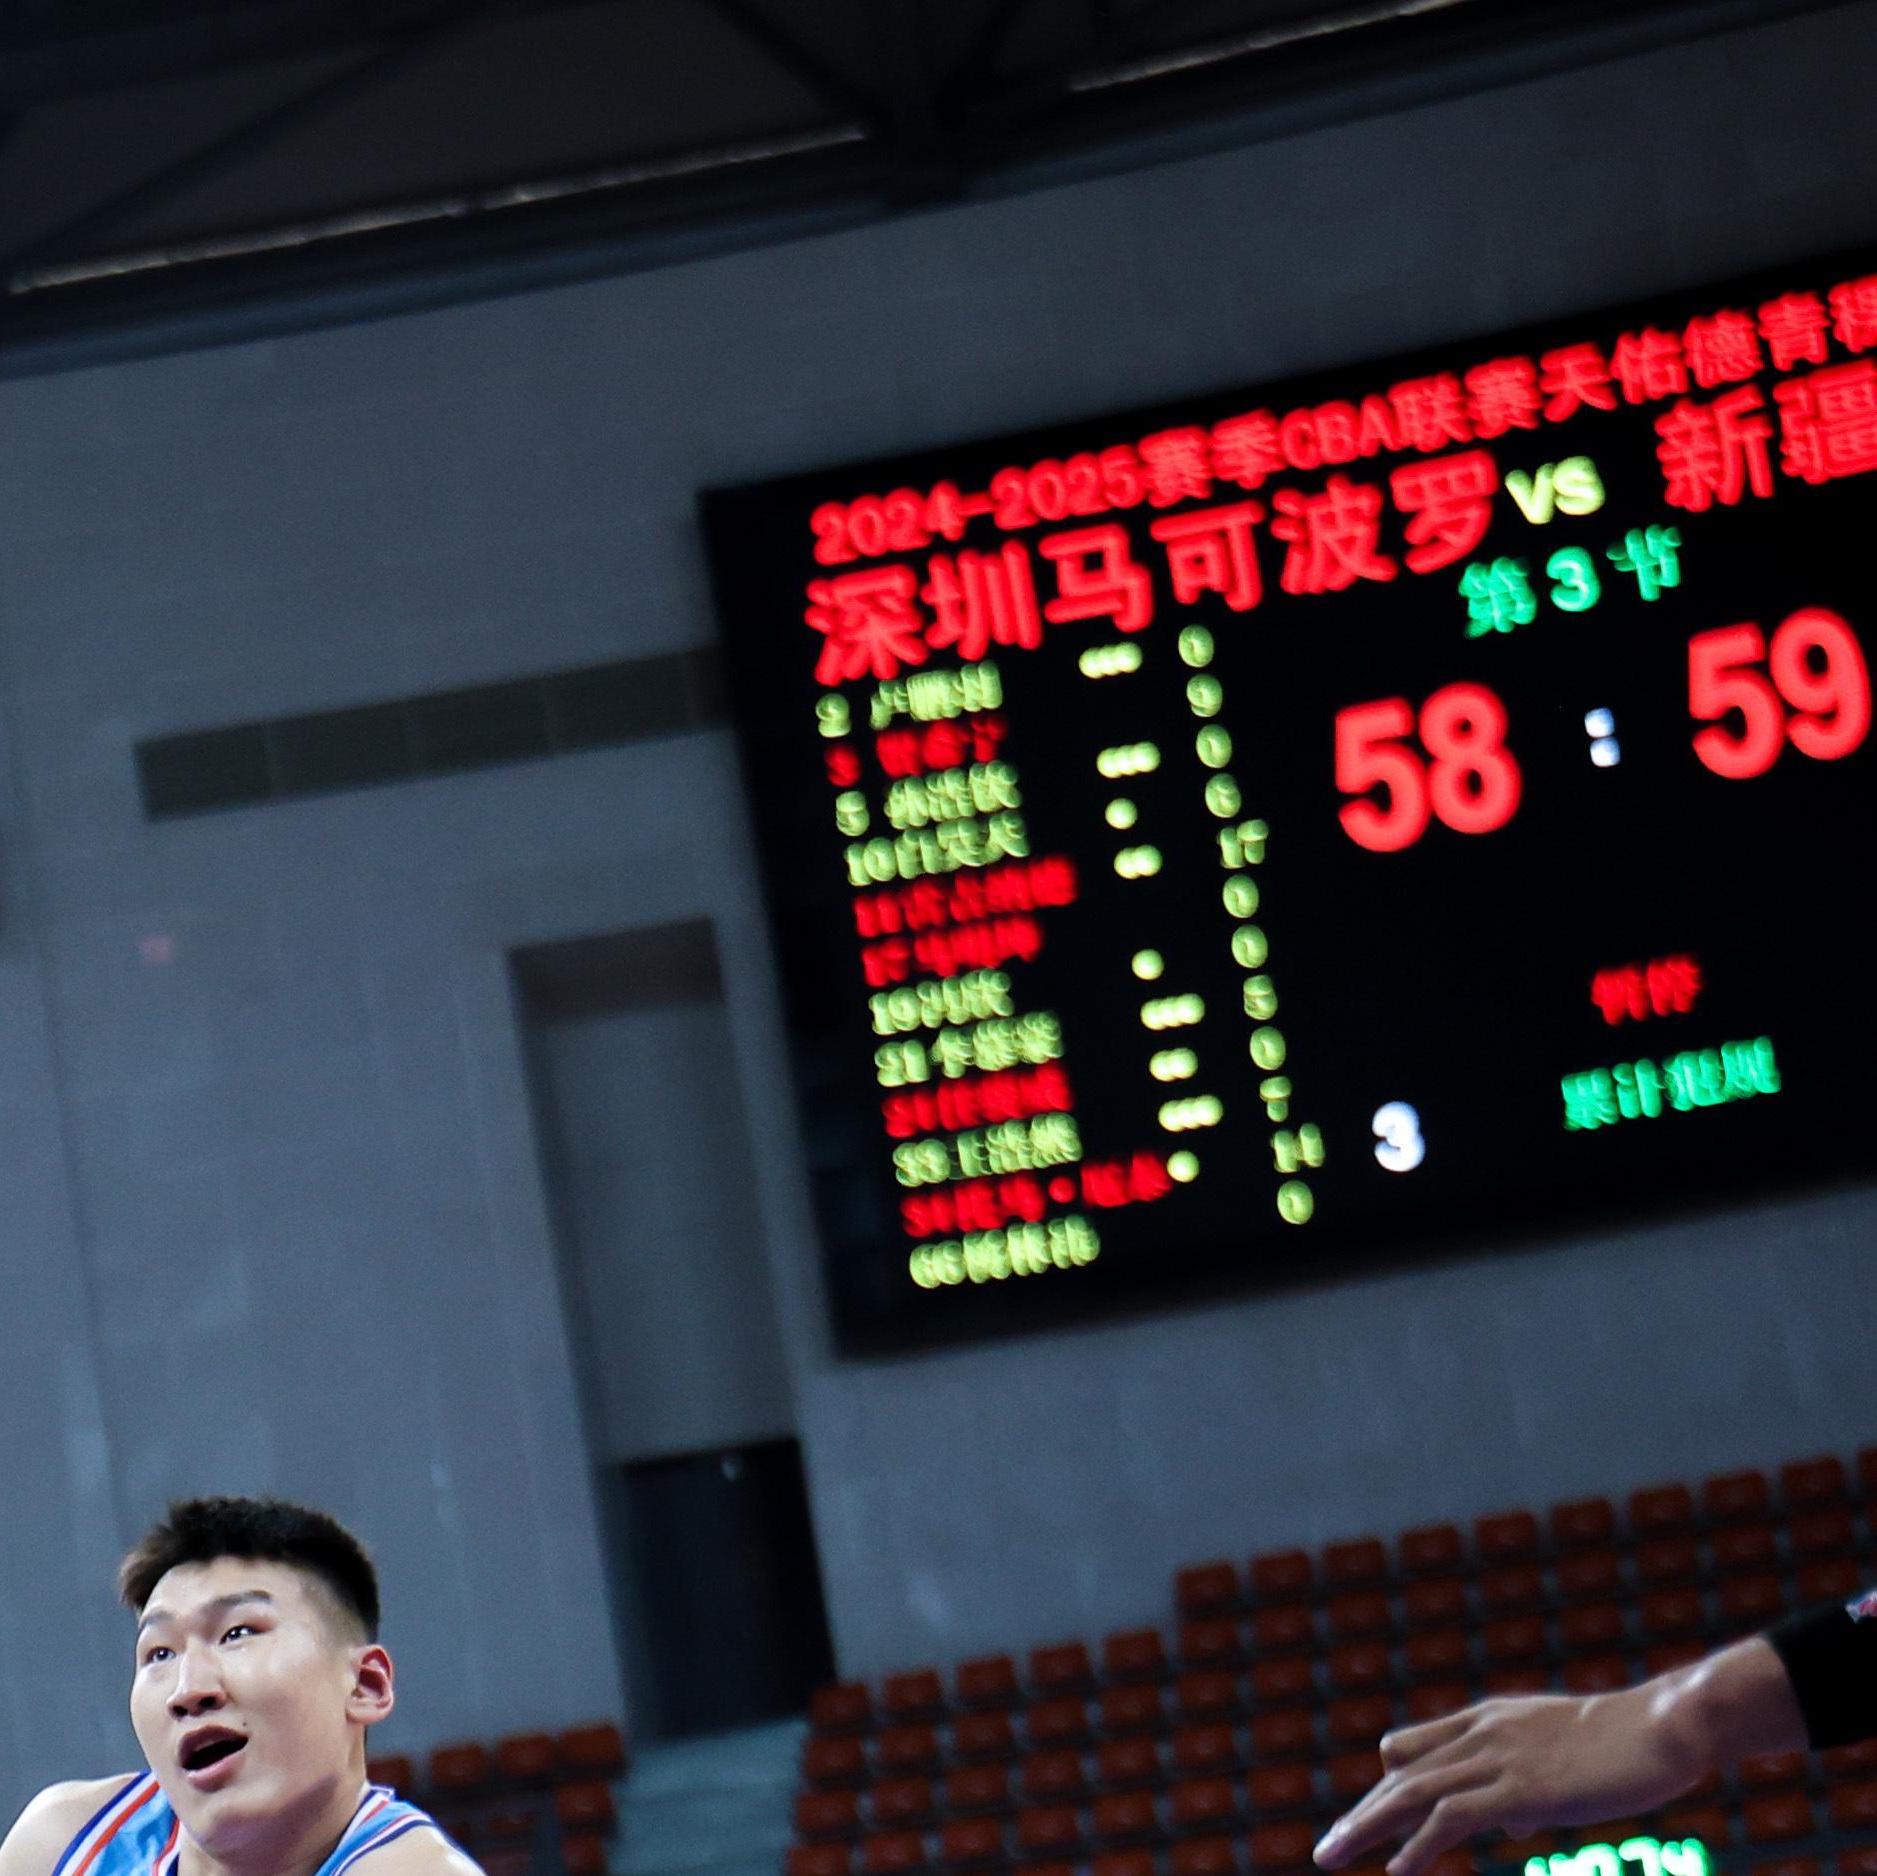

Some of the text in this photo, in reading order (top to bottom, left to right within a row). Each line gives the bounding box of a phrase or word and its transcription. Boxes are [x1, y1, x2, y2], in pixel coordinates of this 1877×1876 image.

[804, 449, 1498, 687] 深圳马可波罗
[1655, 358, 1877, 513] 新疆
[1335, 681, 1522, 853] 58
[1688, 606, 1873, 779] 59
[1372, 1101, 1426, 1173] 3
